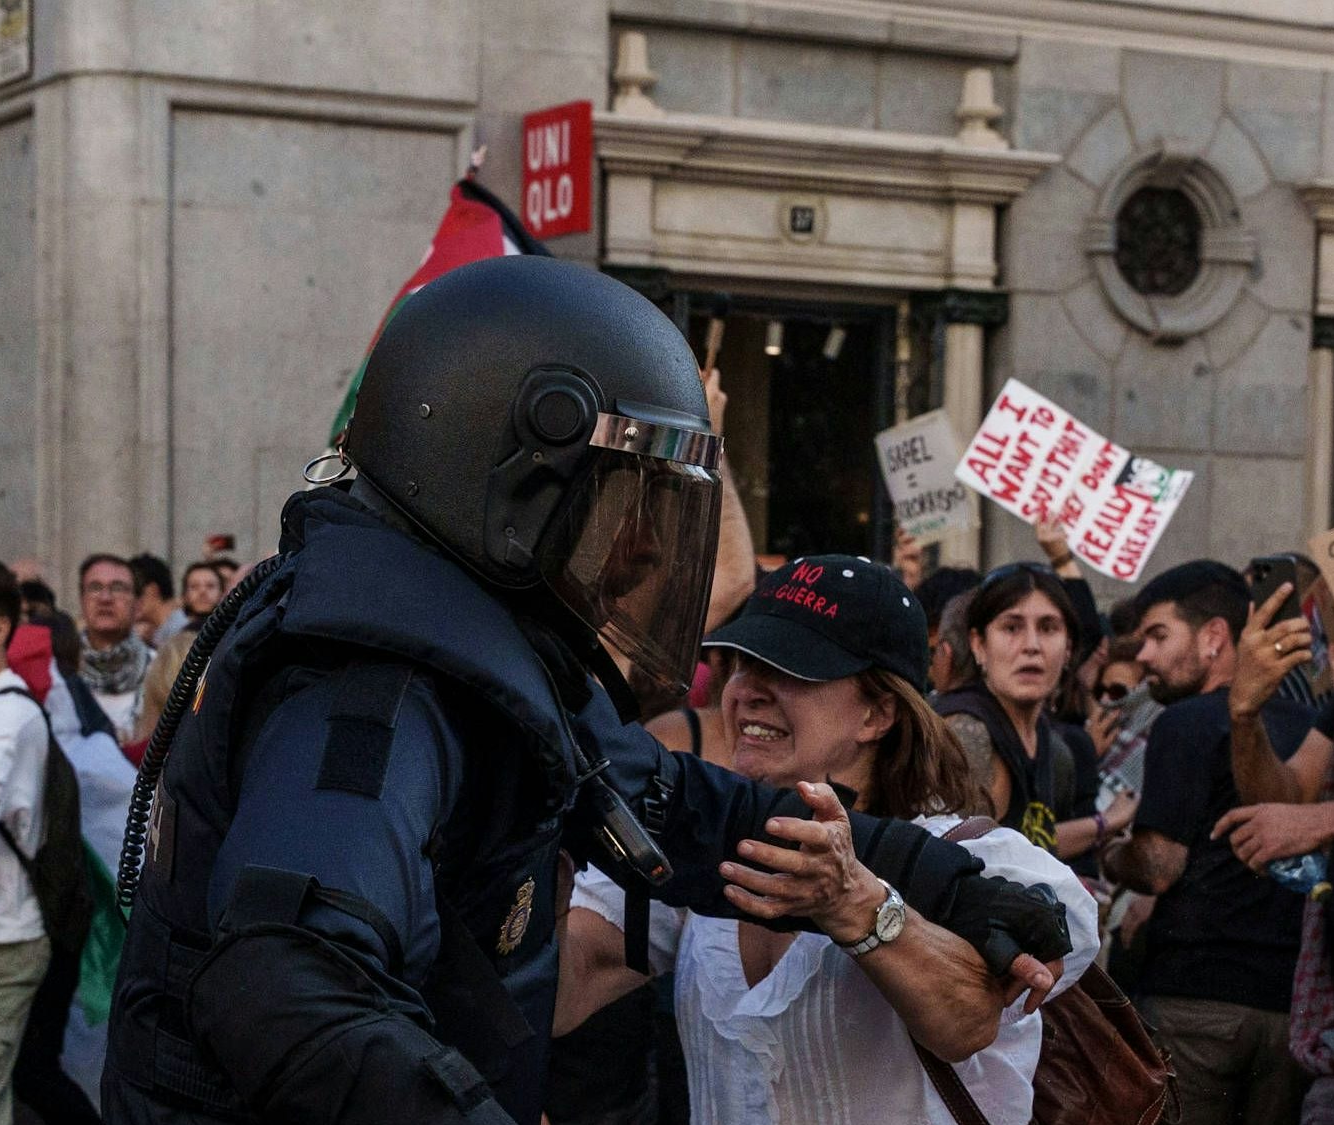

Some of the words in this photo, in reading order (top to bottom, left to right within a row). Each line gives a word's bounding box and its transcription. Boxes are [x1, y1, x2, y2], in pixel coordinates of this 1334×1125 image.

[528, 119, 569, 171] UNI
[528, 173, 573, 231] QLO
[966, 430, 1010, 485] ALL
[999, 395, 1027, 423] I
[991, 431, 1040, 503] WANT
[1030, 406, 1056, 430] TO
[1047, 420, 1088, 472] THAT
[1076, 484, 1135, 565] REALLY
[791, 562, 824, 585] NO
[775, 584, 839, 619] GUERRA
